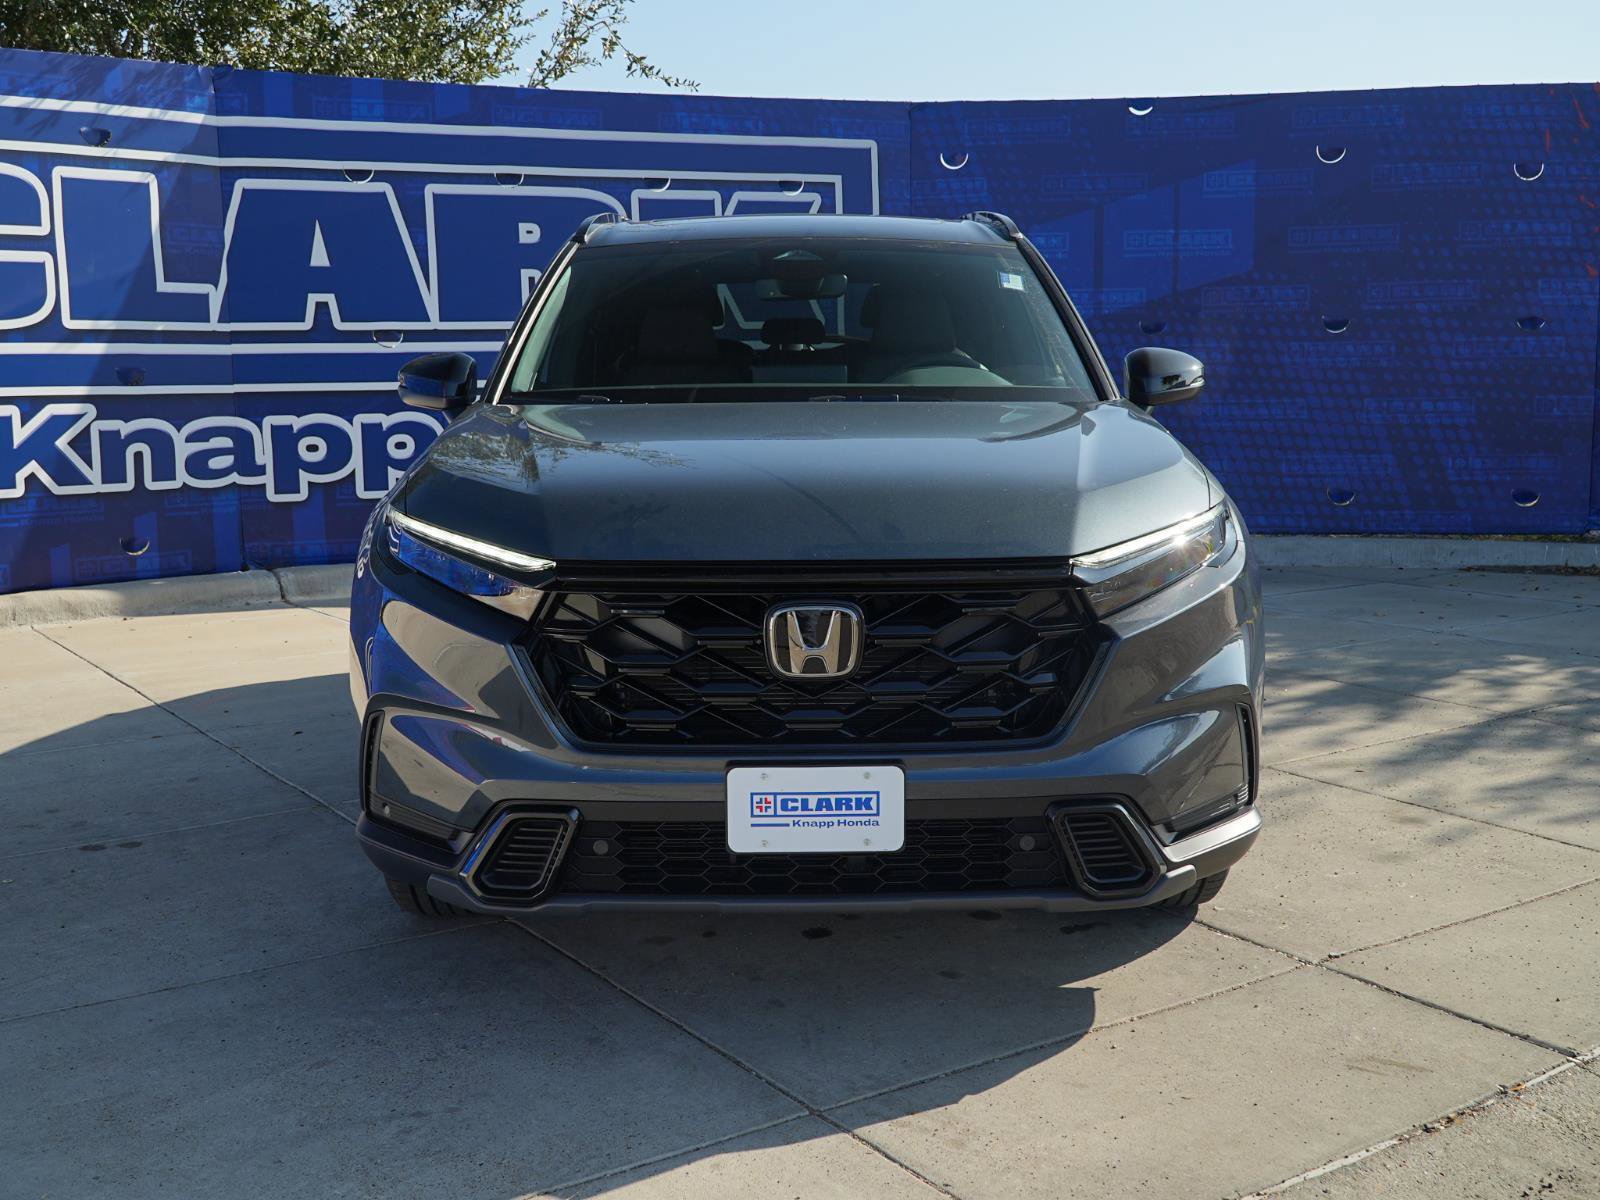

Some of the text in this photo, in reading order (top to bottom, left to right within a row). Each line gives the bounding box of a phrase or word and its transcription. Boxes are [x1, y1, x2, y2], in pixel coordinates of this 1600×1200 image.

[780, 797, 873, 812] CLARK
[792, 818, 880, 829] Knapp Honda
